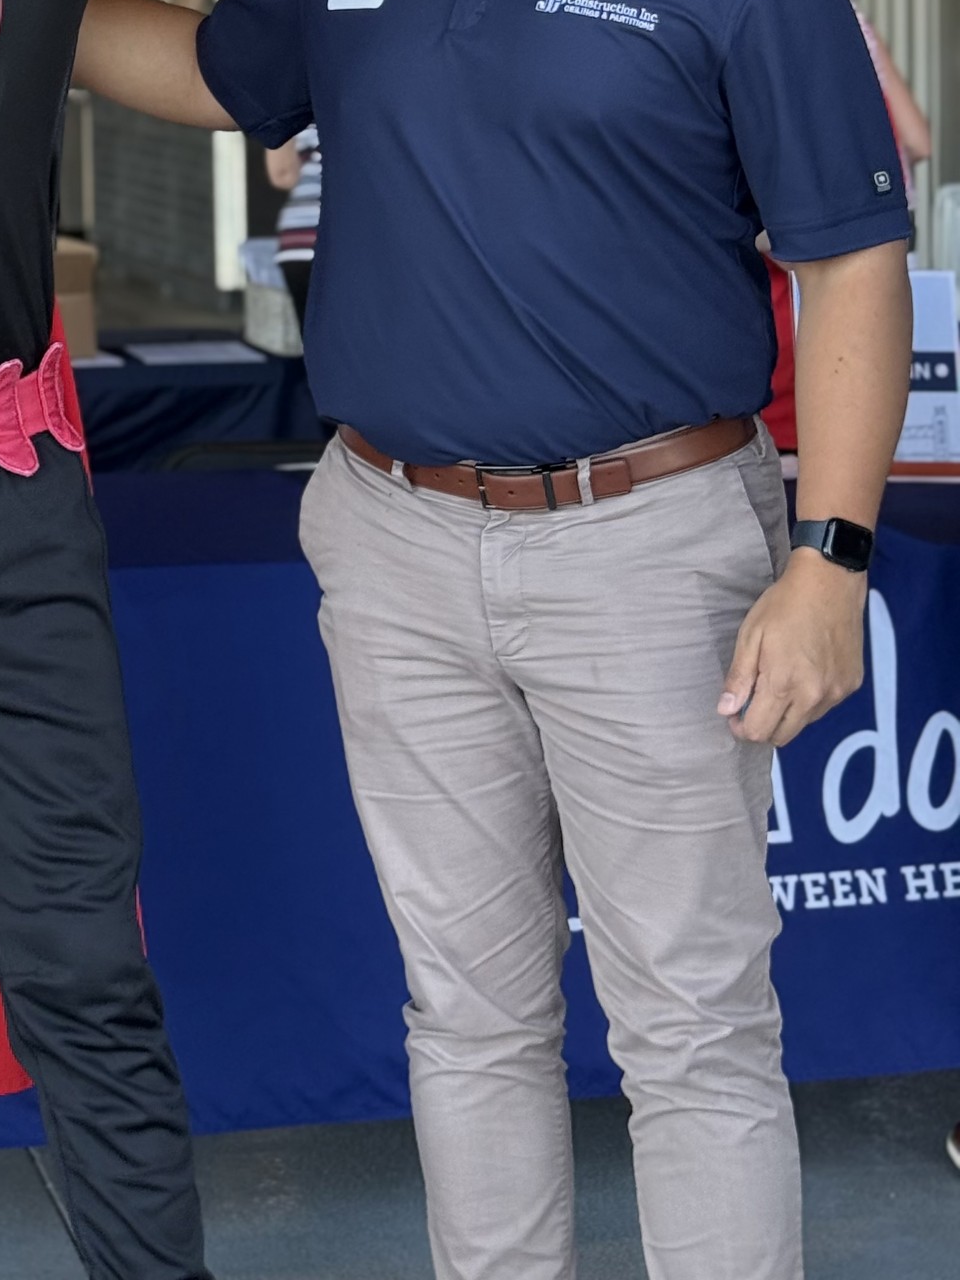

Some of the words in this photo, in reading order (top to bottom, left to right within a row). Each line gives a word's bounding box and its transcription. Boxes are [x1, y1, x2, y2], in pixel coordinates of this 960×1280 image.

[563, 4, 600, 19] CEILINGS
[601, 12, 608, 20] &
[609, 13, 655, 32] PARTITIONS
